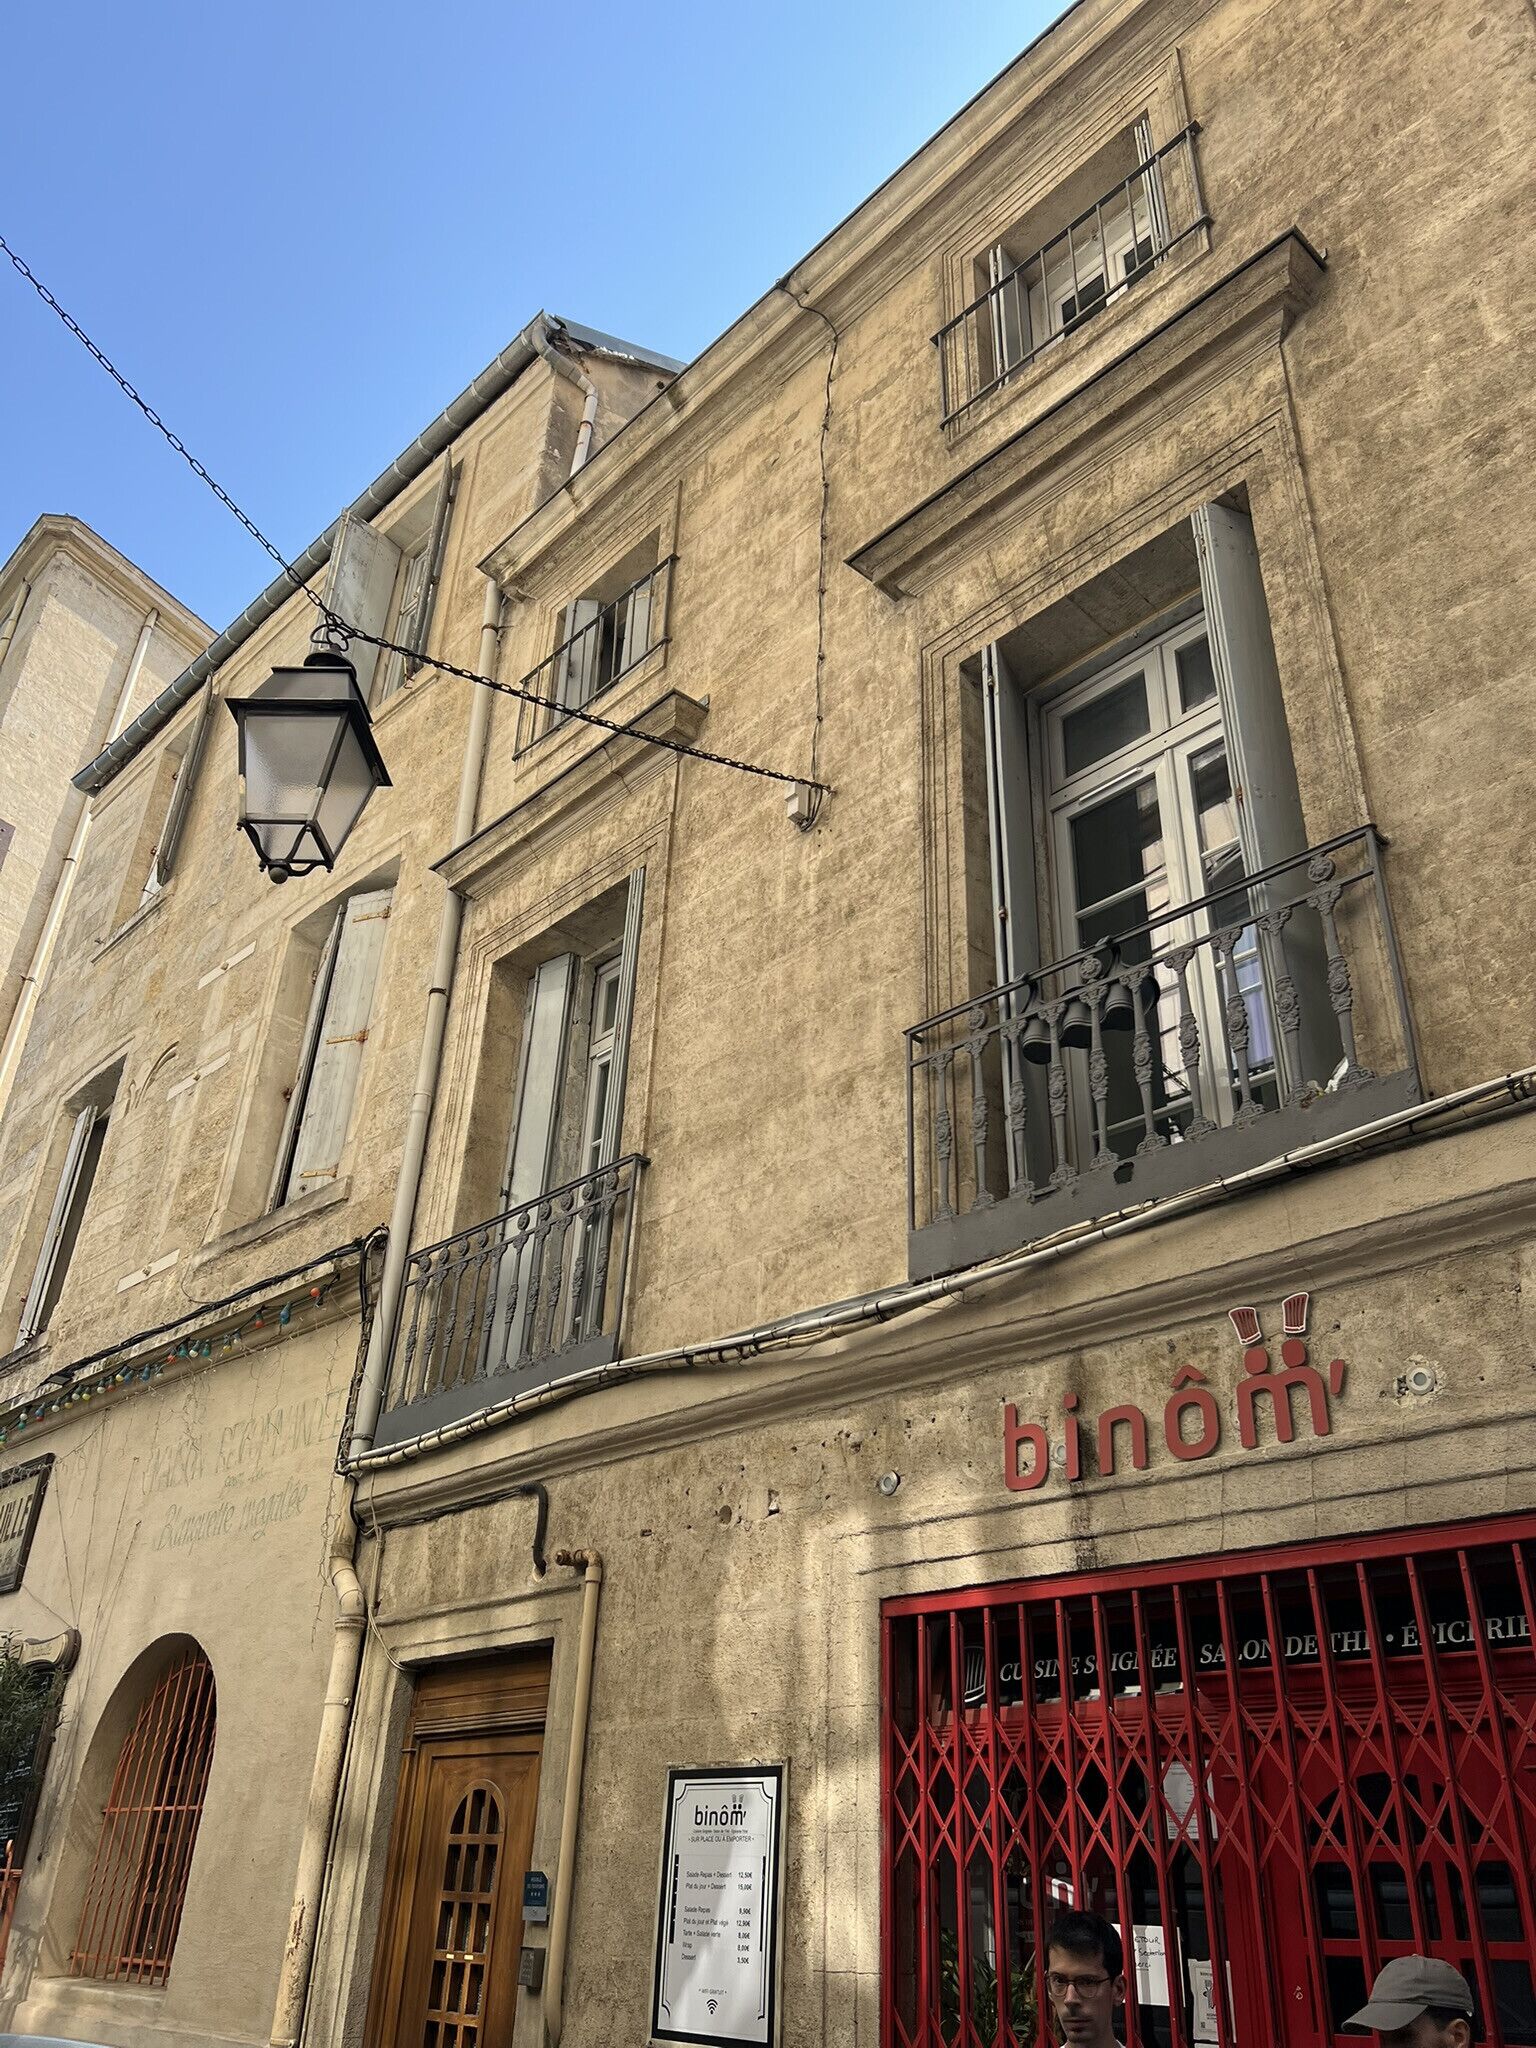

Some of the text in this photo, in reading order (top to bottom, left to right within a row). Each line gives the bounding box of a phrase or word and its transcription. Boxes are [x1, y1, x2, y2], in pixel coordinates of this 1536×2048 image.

[1200, 1638, 1273, 1664] SAON
[1285, 1634, 1318, 1657] DE
[1000, 1656, 1080, 1682] CUSINE
